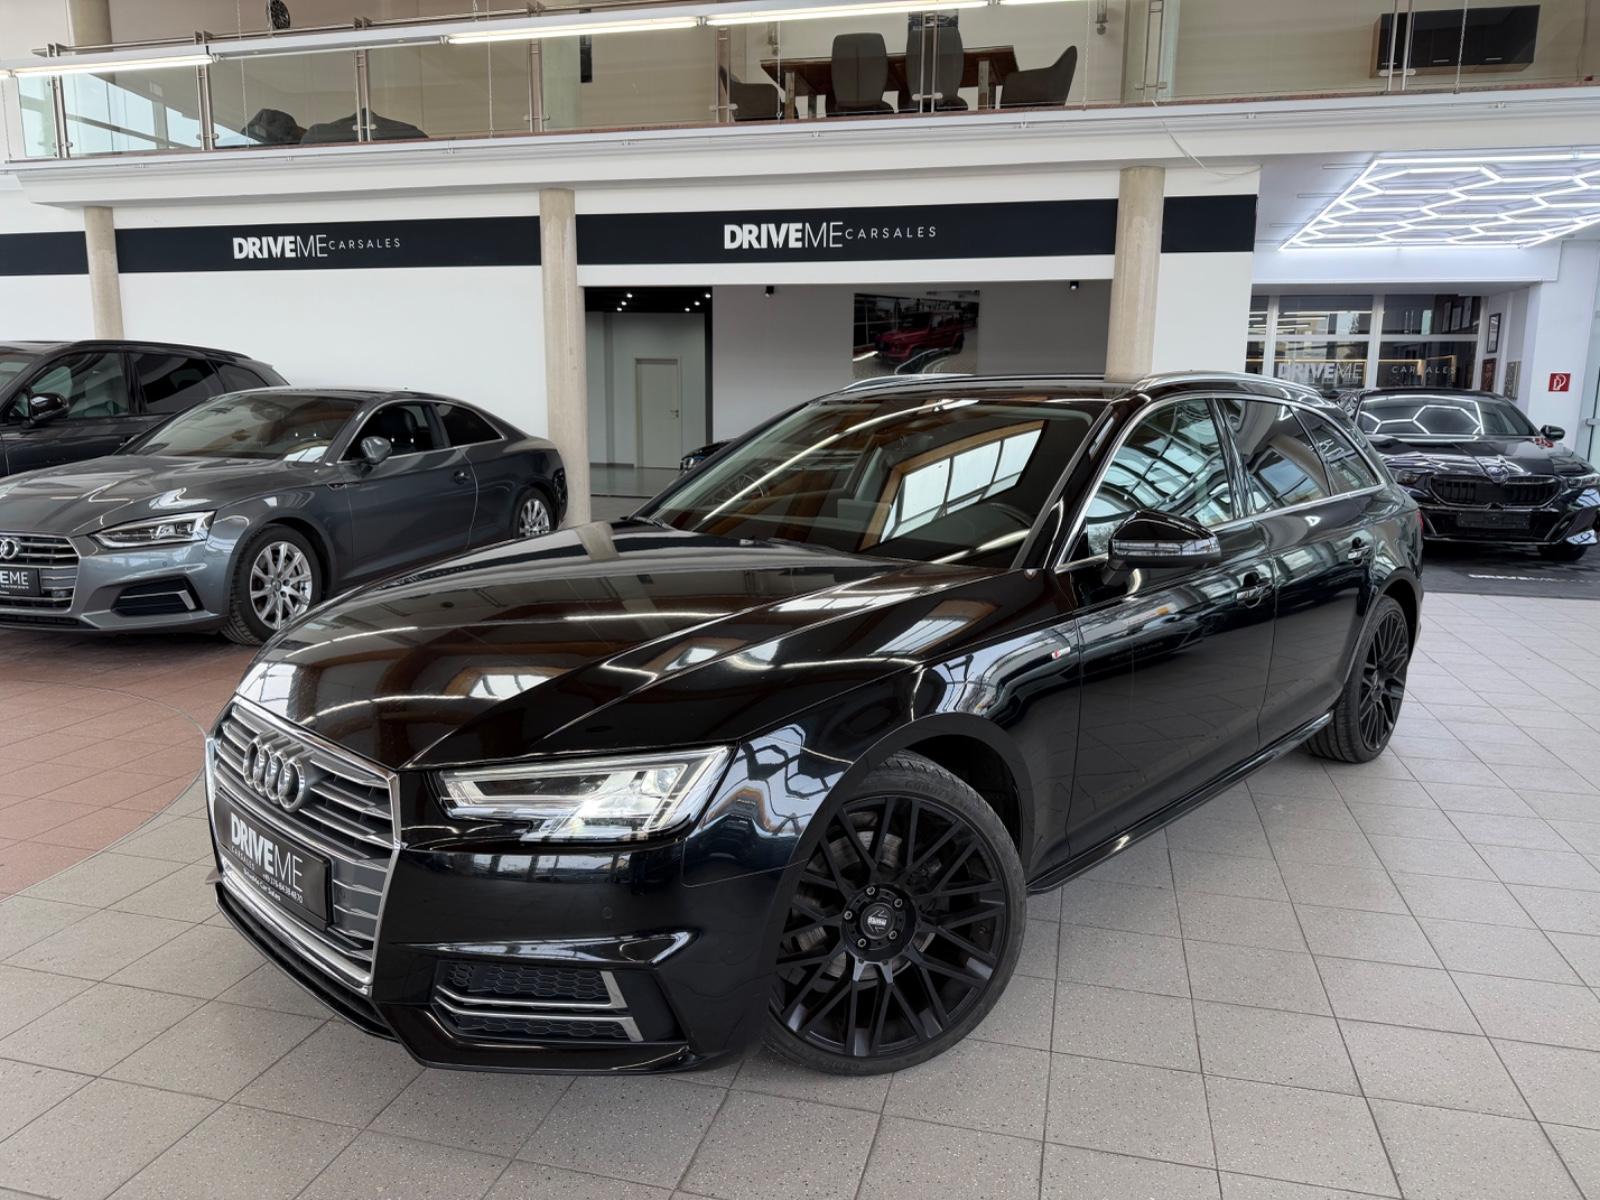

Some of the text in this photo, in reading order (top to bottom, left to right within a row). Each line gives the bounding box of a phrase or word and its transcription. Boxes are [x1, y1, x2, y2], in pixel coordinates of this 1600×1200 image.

[232, 234, 401, 260] DRIVEME CARSALES
[723, 221, 937, 250] DRIVEME CARSALES
[1391, 365, 1457, 375] CARALES
[230, 811, 303, 892] DRIVEME
